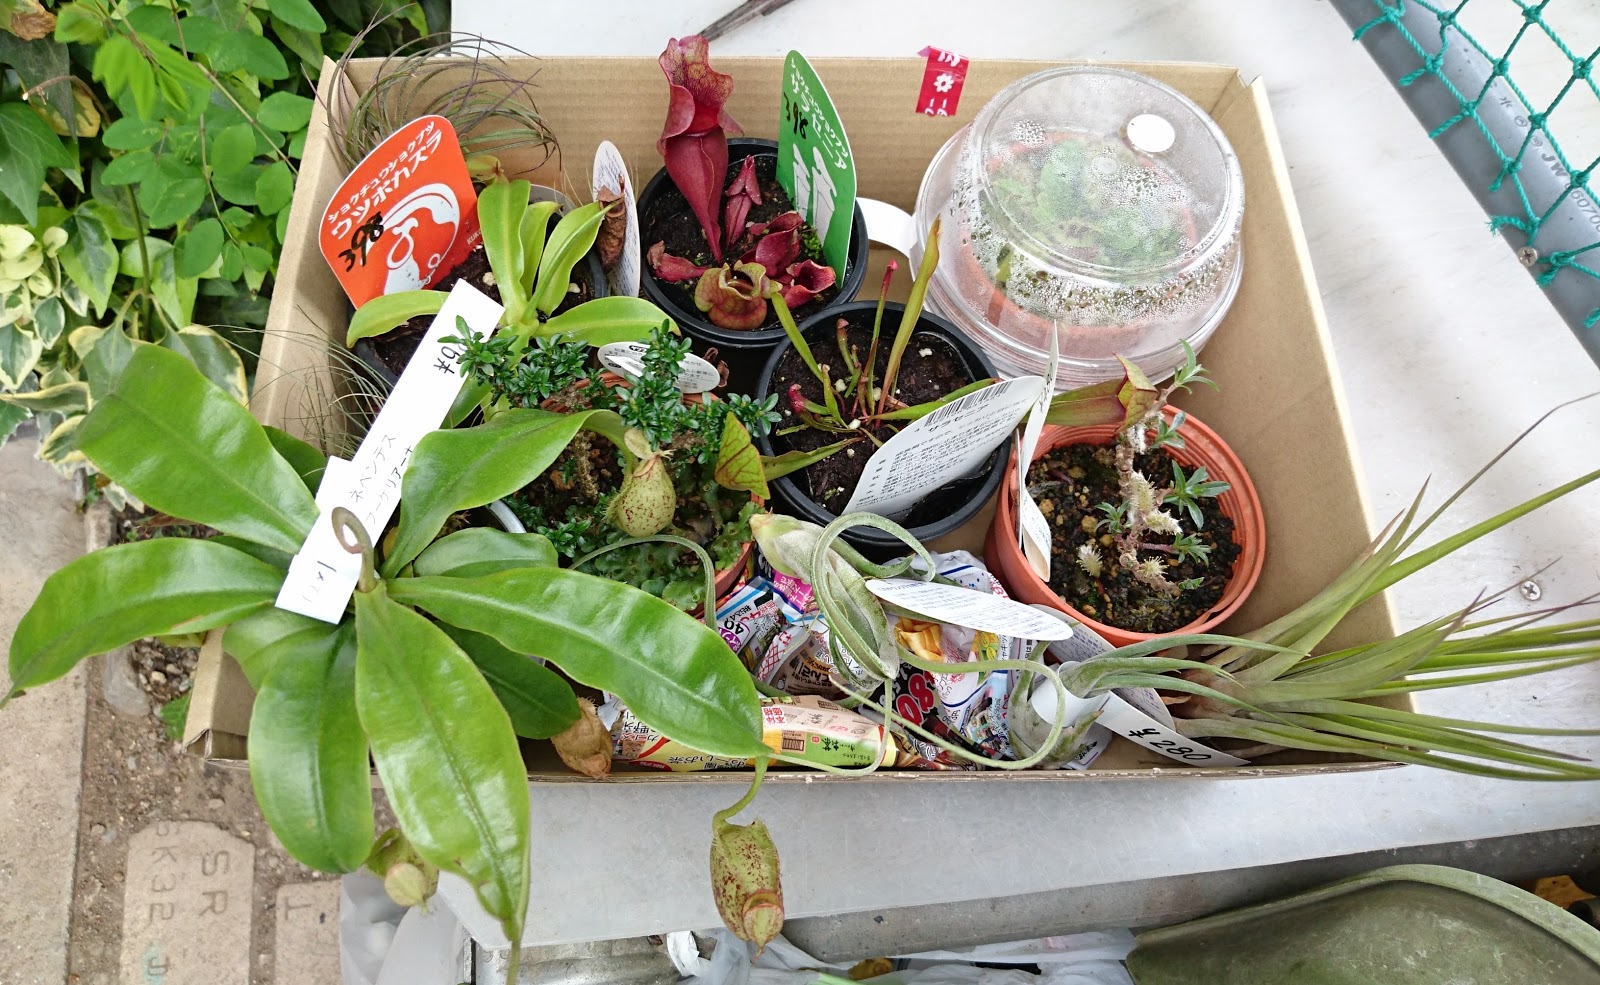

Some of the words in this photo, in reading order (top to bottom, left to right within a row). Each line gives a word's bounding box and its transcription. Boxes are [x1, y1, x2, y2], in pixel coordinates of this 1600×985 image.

[791, 73, 848, 169] サラセニア
[328, 121, 435, 224] ショクチュウショクブツ
[331, 129, 442, 240] ウツボカズラ
[338, 211, 384, 273] 398
